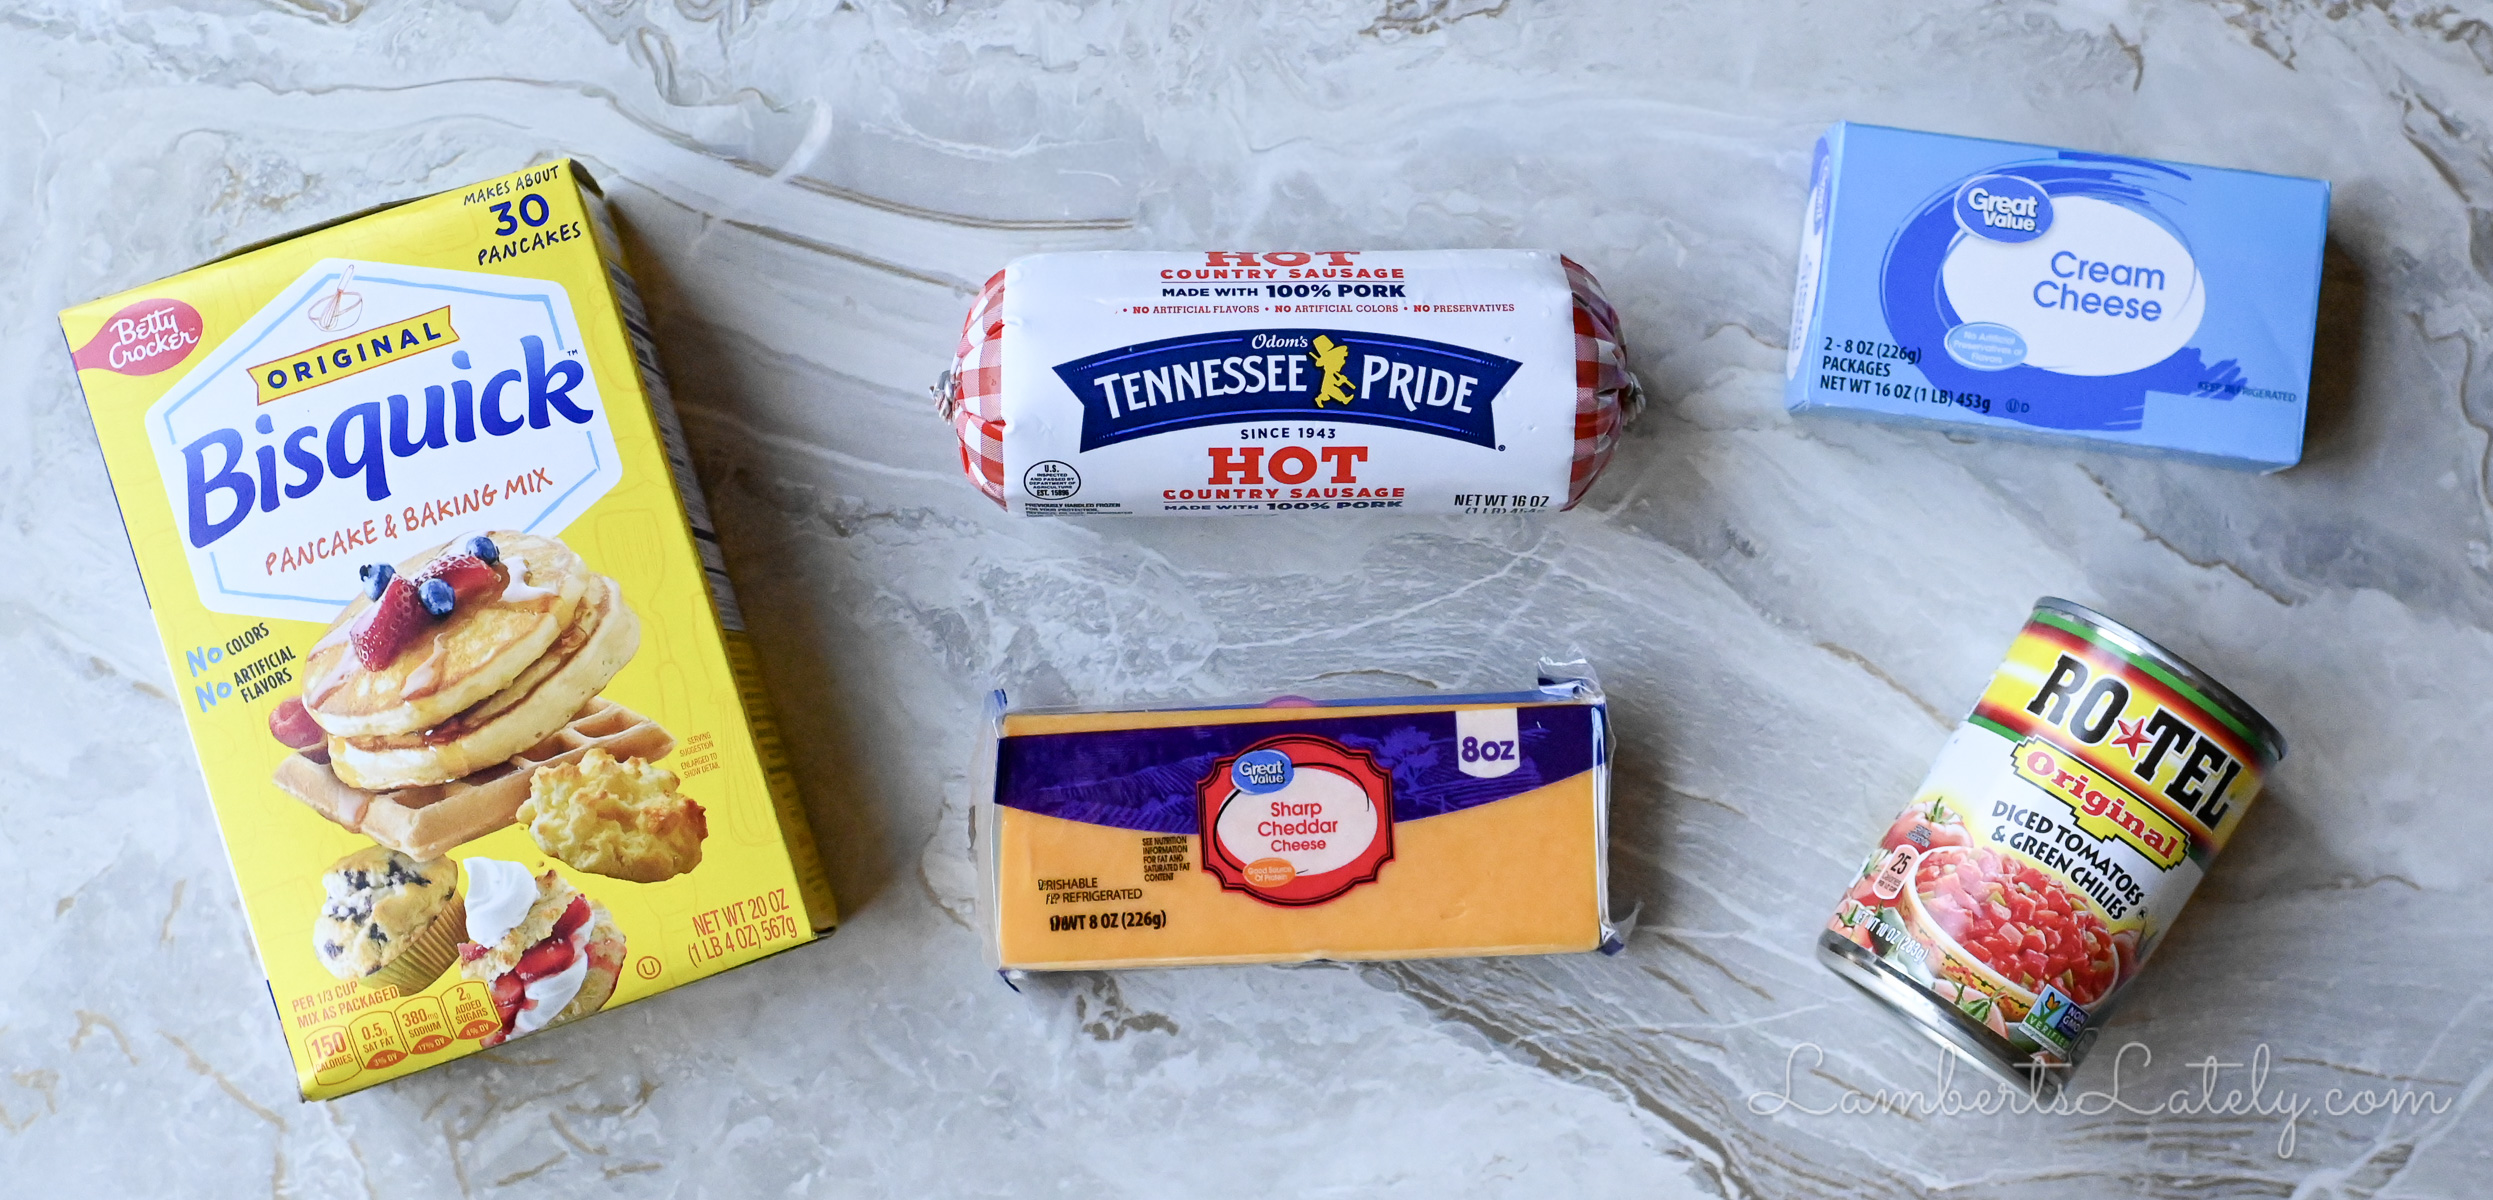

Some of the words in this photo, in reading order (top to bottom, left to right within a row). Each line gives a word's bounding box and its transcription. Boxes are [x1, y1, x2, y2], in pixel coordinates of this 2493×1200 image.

[464, 180, 510, 206] MAKES
[515, 166, 560, 194] ABOUT
[1966, 187, 2038, 219] Great
[488, 192, 551, 237] 30
[1982, 209, 2038, 234] Value
[476, 222, 583, 266] PANCAKES
[1204, 250, 1361, 267] HOT
[1160, 268, 1278, 280] COUNTRY
[1288, 268, 1405, 280] SAUSAGE
[2050, 250, 2166, 291] Cream
[1162, 288, 1210, 298] MADE
[1214, 287, 1258, 297] WITH
[1266, 284, 1332, 298] 100%
[1336, 284, 1406, 298] PORK
[1132, 305, 1150, 314] NO
[1152, 304, 1212, 314] ARTIFICIAL
[1213, 304, 1260, 314] FLAVORS
[1274, 304, 1292, 314] NO
[1294, 304, 1354, 314] ARTIFICIAL
[1356, 304, 1399, 314] COLORS
[1413, 304, 1431, 314] NO
[1433, 303, 1516, 313] PRESERVATIVES
[2032, 280, 2163, 324] Cheese
[109, 306, 179, 346] Betty
[1251, 334, 1308, 350] Odom's
[1963, 331, 1978, 340] No
[1978, 332, 2016, 344] Artificial
[108, 327, 199, 366] Crocker
[1824, 336, 1833, 350] 2
[1844, 339, 1854, 354] 8
[1856, 340, 1874, 356] OZ
[1877, 342, 1922, 365] (226g)
[1953, 340, 2011, 354] Preservatives
[266, 320, 443, 391] ORIGINAL
[1971, 352, 2004, 364] Flavors
[1822, 356, 1891, 377] PACKAGES
[1094, 354, 1308, 420] TENNESSEE
[1360, 354, 1480, 416] PRIDE
[1820, 374, 1847, 390] NET
[1849, 378, 1872, 394] WT
[1875, 382, 1891, 398] 16
[1894, 384, 1912, 400] OZ
[1914, 386, 1928, 404] (1
[1931, 388, 1954, 408] LB)
[1957, 392, 1991, 414] 453g
[181, 334, 595, 549] Bisquick
[1240, 427, 1291, 440] SINCE
[1298, 427, 1336, 440] 1943
[1044, 464, 1060, 473] U.S.
[1207, 446, 1368, 486] HOT
[1162, 488, 1280, 500] COUNTRY
[1290, 488, 1406, 499] SAUSAGE
[1454, 494, 1482, 506] NET
[1484, 494, 1508, 506] WT
[1512, 494, 1526, 507] 16
[1530, 496, 1550, 508] OZ
[1164, 504, 1212, 512] MADE
[1266, 502, 1330, 512] 100%
[1336, 500, 1404, 510] PORK
[266, 520, 379, 578] PANCAKE
[384, 516, 398, 540] &
[403, 483, 499, 533] BAKING
[505, 466, 554, 501] MIX
[226, 622, 270, 656] COLORS
[234, 646, 296, 687] ARTIFICIAL
[240, 667, 293, 704] FLAVORS
[687, 731, 712, 745] SERVING
[680, 740, 714, 758] SUGGESTION
[680, 755, 710, 770] ENLARGED
[710, 752, 718, 761] TO
[1238, 760, 1284, 776] Great
[684, 768, 701, 778] SHOW
[702, 762, 720, 773] DETAIL
[1249, 774, 1285, 786] Value
[1270, 802, 1322, 818] Sharp
[2023, 750, 2181, 864] Original
[1258, 820, 1338, 836] Cheddar
[1142, 838, 1153, 846] SEE
[1154, 836, 1187, 845] NUTRITION
[1142, 845, 1188, 854] INFORMATION
[1270, 838, 1326, 852] Cheese
[1143, 855, 1156, 864] FOR
[1157, 854, 1168, 864] FAT
[1168, 854, 1184, 862] AND
[1992, 800, 2054, 834] DICED
[2054, 824, 2145, 906] TOMATOES
[1144, 863, 1178, 873] SATURATED
[1179, 862, 1190, 872] FAT
[1248, 866, 1268, 874] Good
[1268, 866, 1292, 874] Source
[1890, 852, 1912, 875] 25
[1144, 872, 1174, 882] CONTENT
[1264, 874, 1288, 882] Protein
[1992, 825, 2006, 843] &
[2010, 832, 2074, 874] GREEN
[2070, 866, 2128, 920] CHILIES
[1062, 888, 1142, 903] REFRIGERATED
[692, 909, 721, 938] NET
[722, 902, 746, 928] WT
[748, 896, 768, 920] 20
[768, 888, 790, 914] OZ
[1089, 914, 1098, 929] 8
[1100, 912, 1119, 928] OZ
[1122, 910, 1166, 930] (226g)
[688, 942, 702, 968] (1
[702, 936, 724, 960] LB
[725, 932, 736, 952] 4
[736, 924, 762, 950] OZ)
[761, 914, 798, 942] 567g
[1852, 908, 1868, 926] NET
[1864, 916, 1880, 932] WT
[1876, 922, 1888, 938] 10
[1886, 927, 1901, 946] OZ
[1896, 936, 1930, 964] (283g)
[292, 993, 315, 1012] PER
[316, 989, 334, 1006] 1/3
[334, 980, 358, 1000] CUP
[296, 1012, 320, 1029] MIX
[322, 1006, 338, 1022] AS
[339, 985, 399, 1016] PACKAGED
[455, 999, 482, 1014] ADDED
[2068, 1006, 2086, 1023] NON
[455, 1008, 489, 1025] SUGARS
[2062, 1016, 2081, 1032] GMO
[408, 1020, 442, 1038] SODIUM
[466, 1027, 478, 1037] 4%
[478, 1023, 490, 1034] DV
[2030, 1016, 2071, 1049] VERIFIED
[311, 1031, 347, 1060] 150
[362, 1042, 378, 1054] SAT
[380, 1036, 394, 1048] FAT
[435, 1038, 445, 1047] DV
[316, 1054, 354, 1074] CALORIES
[373, 1056, 386, 1067] 3%
[387, 1052, 398, 1062] DV
